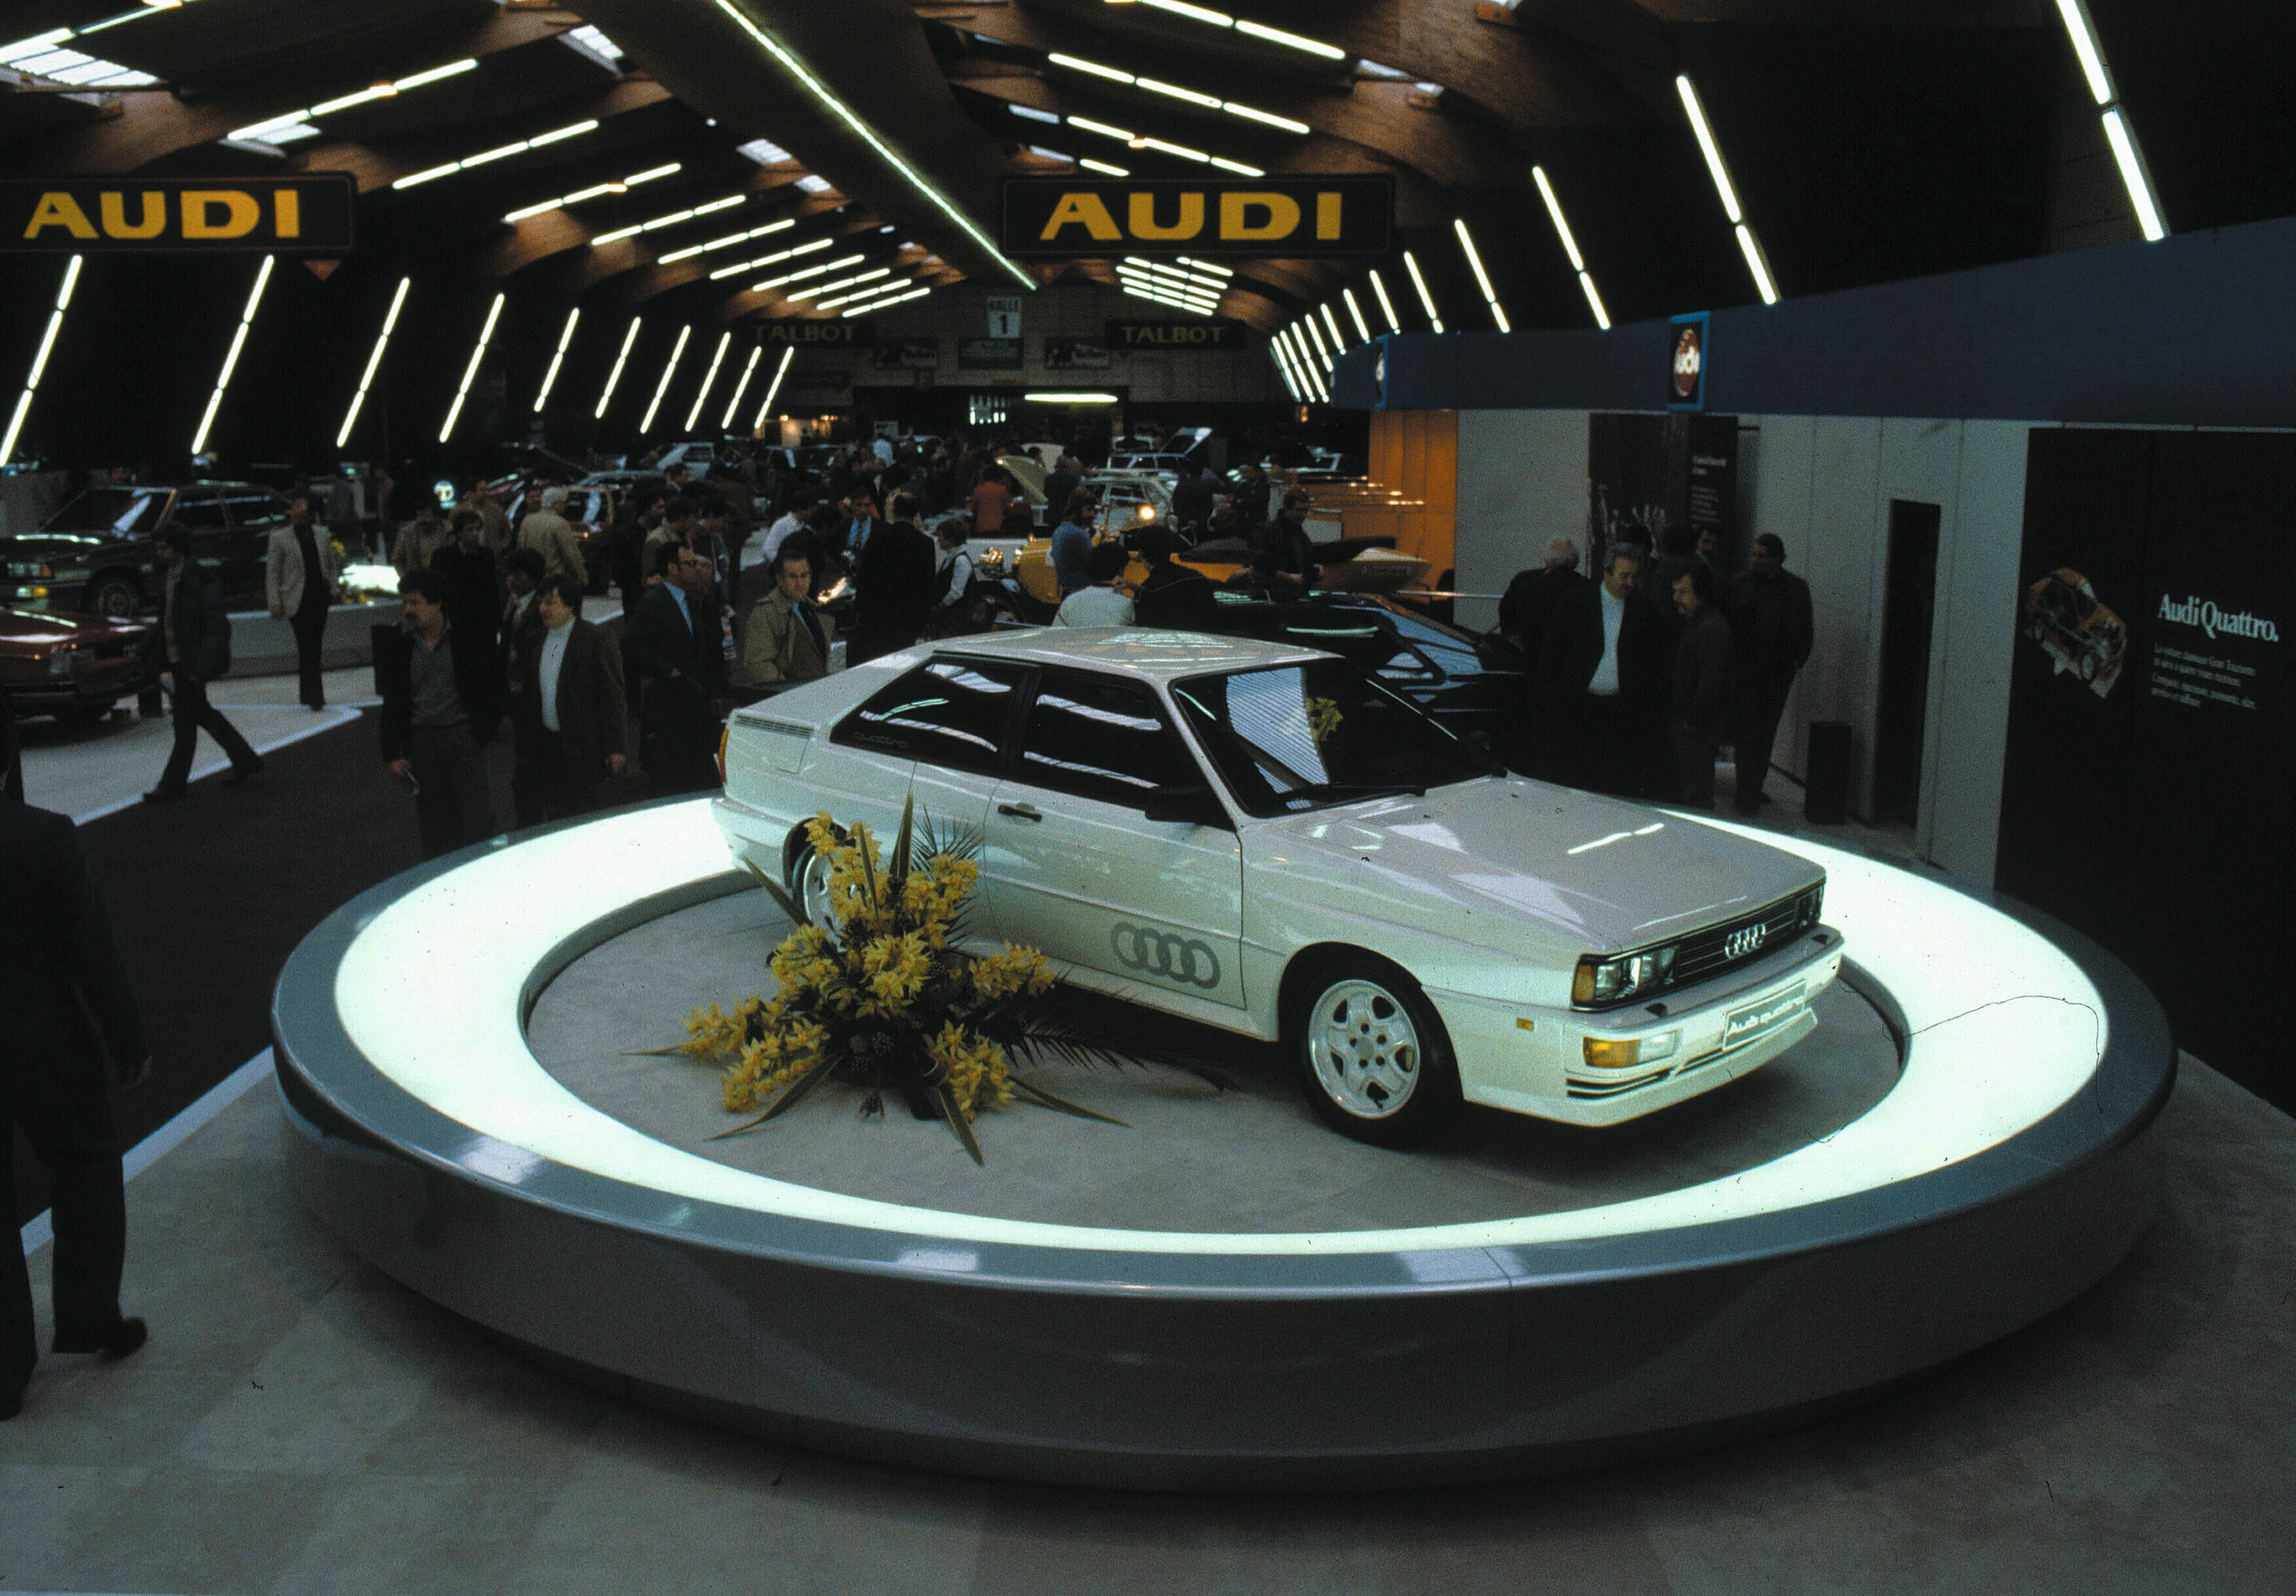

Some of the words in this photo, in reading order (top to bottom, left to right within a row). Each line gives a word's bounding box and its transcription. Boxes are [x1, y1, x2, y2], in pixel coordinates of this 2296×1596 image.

[24, 190, 301, 240] AUDI
[1040, 191, 1343, 241] AUDI
[752, 324, 857, 342] TALBOT
[999, 314, 1008, 335] 1
[1121, 325, 1228, 344] TALBOT
[2157, 593, 2200, 626] Audi
[2200, 601, 2279, 642] Quattro.
[853, 731, 909, 749] quattro
